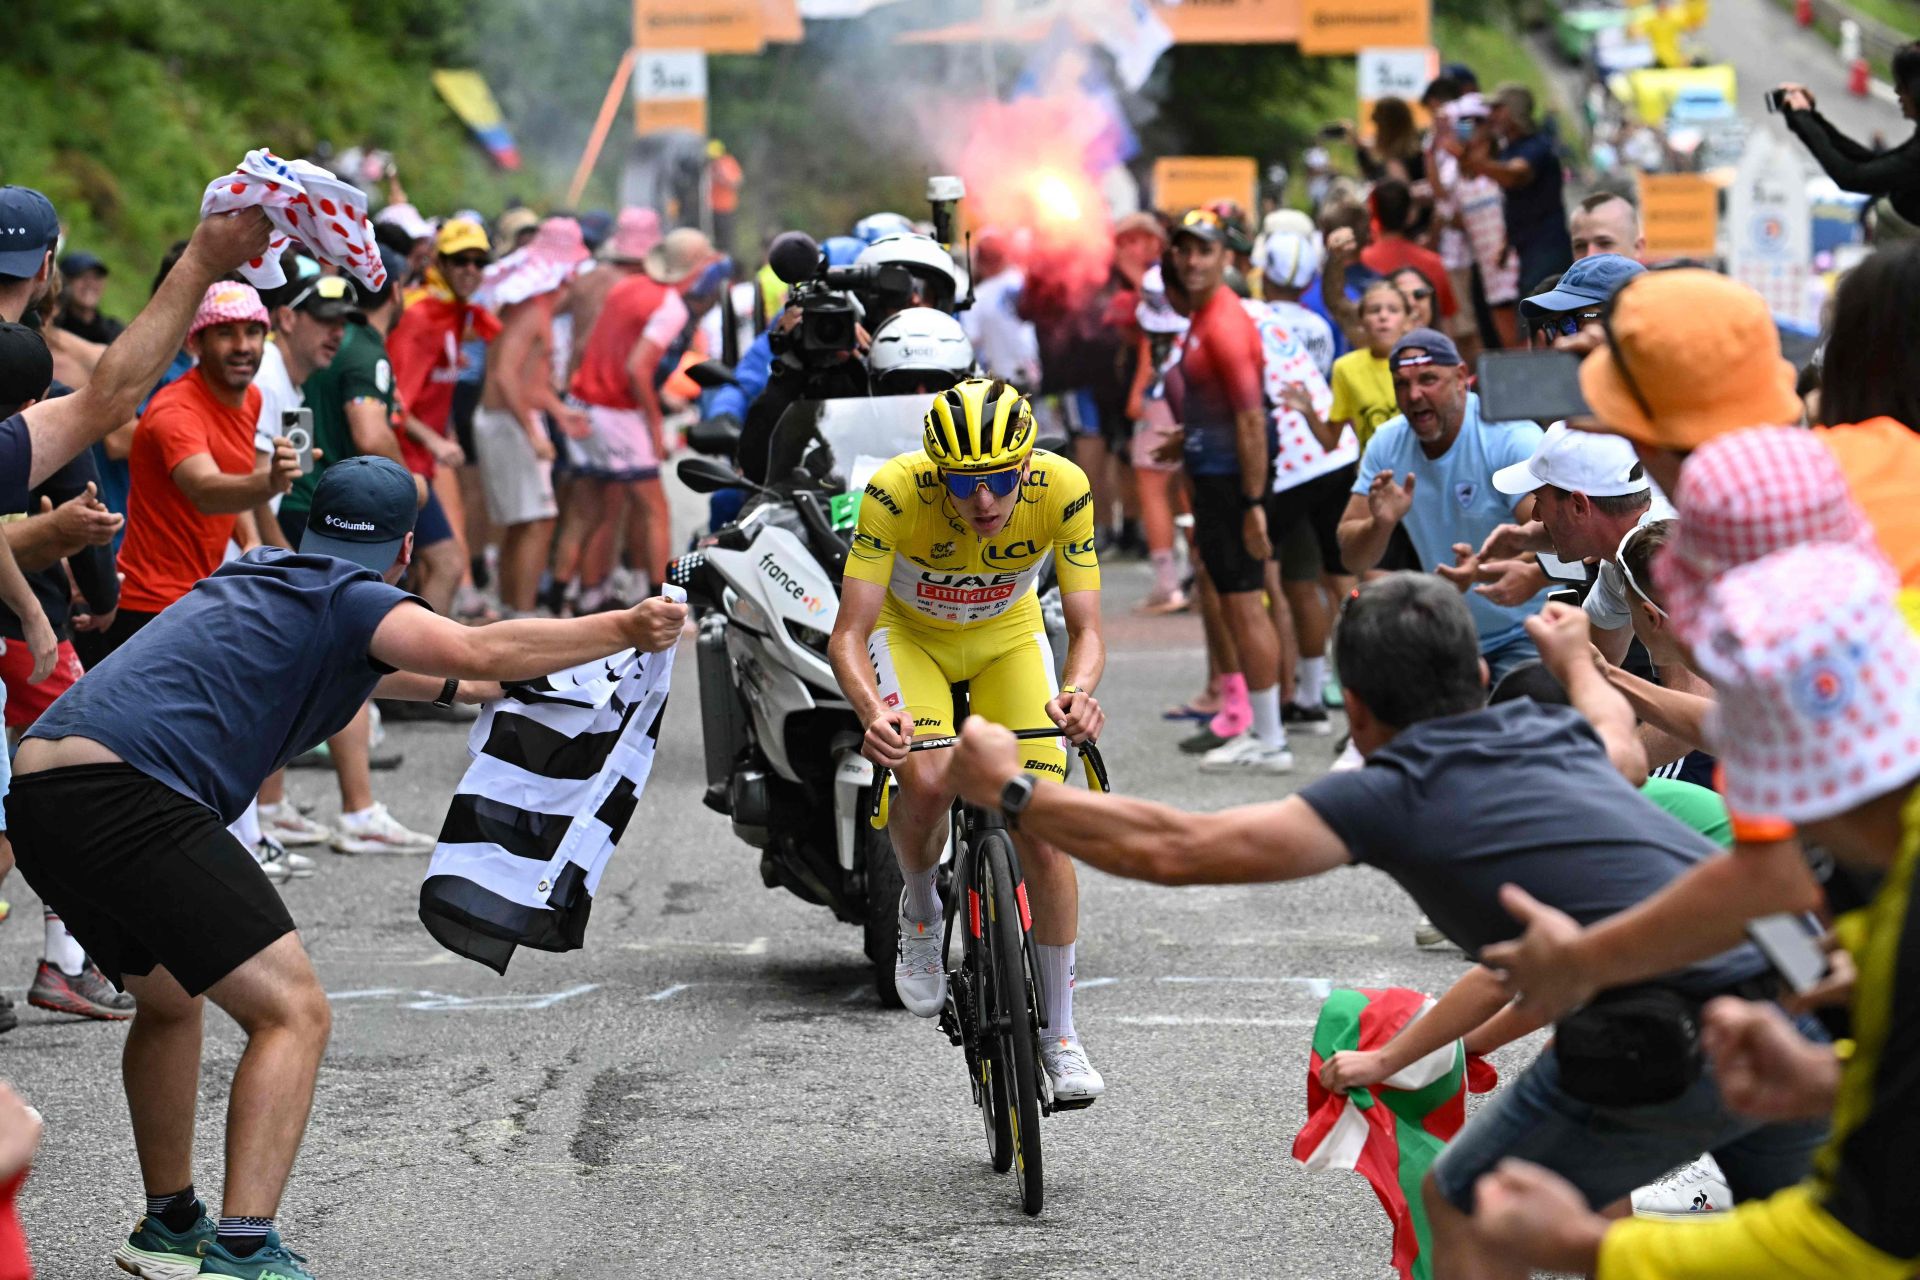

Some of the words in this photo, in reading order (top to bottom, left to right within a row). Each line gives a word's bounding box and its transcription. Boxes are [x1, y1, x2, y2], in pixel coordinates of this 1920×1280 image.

[332, 517, 375, 531] Columbia
[988, 539, 1047, 560] LCL
[920, 571, 1019, 588] UAE
[920, 584, 1012, 603] Emirates
